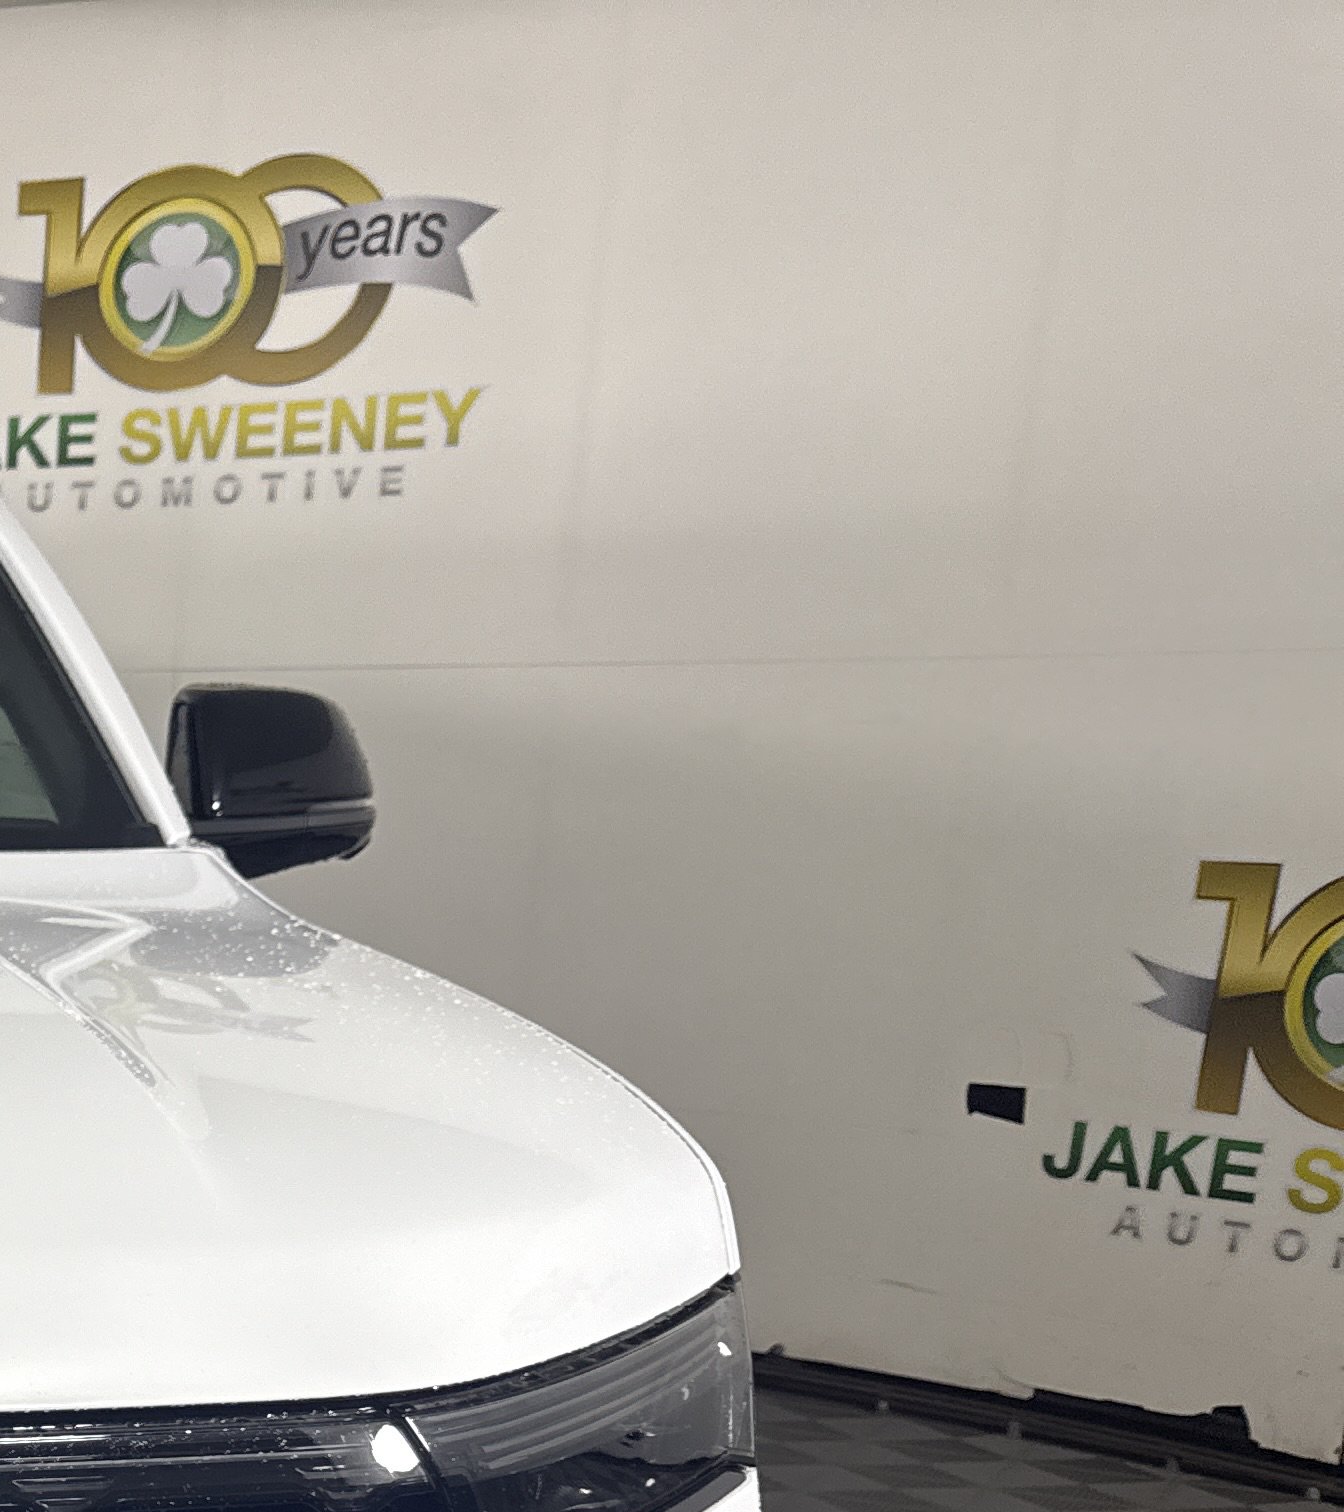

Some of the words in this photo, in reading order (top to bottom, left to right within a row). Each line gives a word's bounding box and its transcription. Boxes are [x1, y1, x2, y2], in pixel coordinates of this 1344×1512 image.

[297, 208, 447, 281] years
[118, 386, 484, 466] SWEENEY
[1041, 1120, 1266, 1204] JAKE
[1286, 1147, 1344, 1215] S
